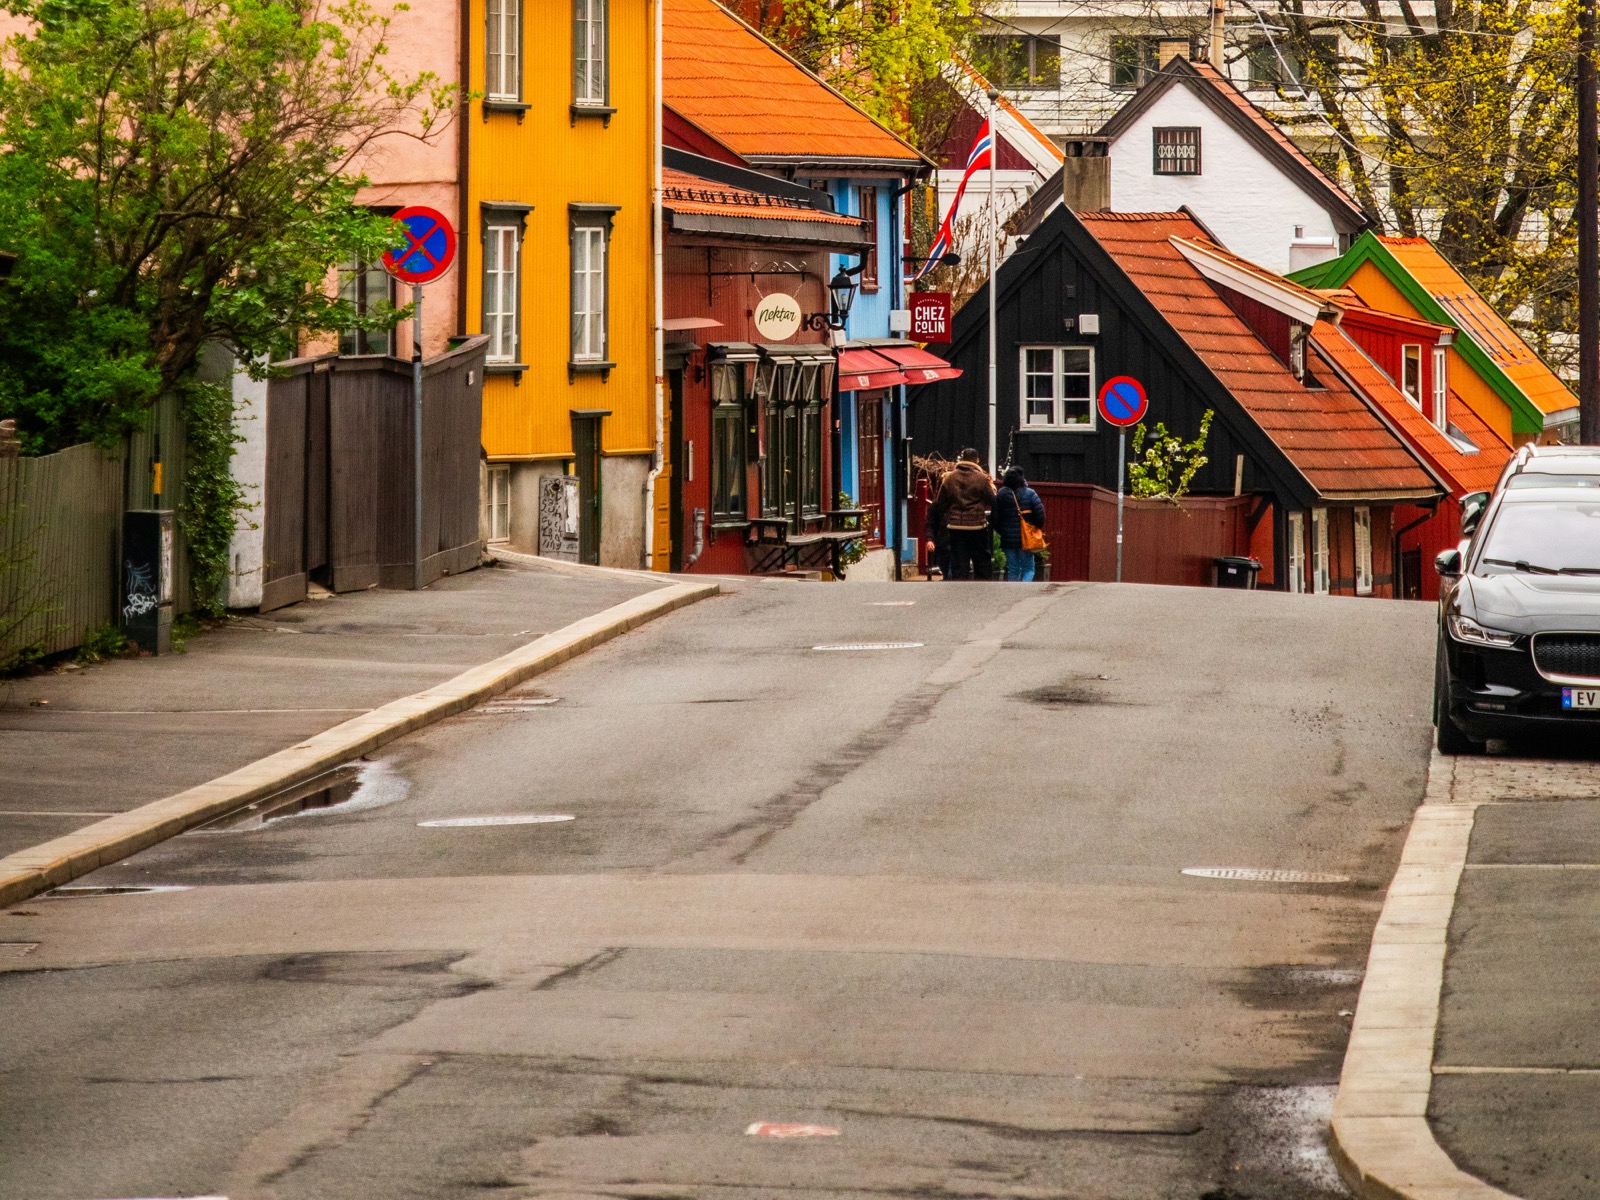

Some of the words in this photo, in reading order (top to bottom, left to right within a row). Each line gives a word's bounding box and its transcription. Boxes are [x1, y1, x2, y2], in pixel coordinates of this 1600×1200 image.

[915, 306, 945, 321] CHEZ
[915, 321, 945, 334] COLIN
[1577, 692, 1596, 706] EV
